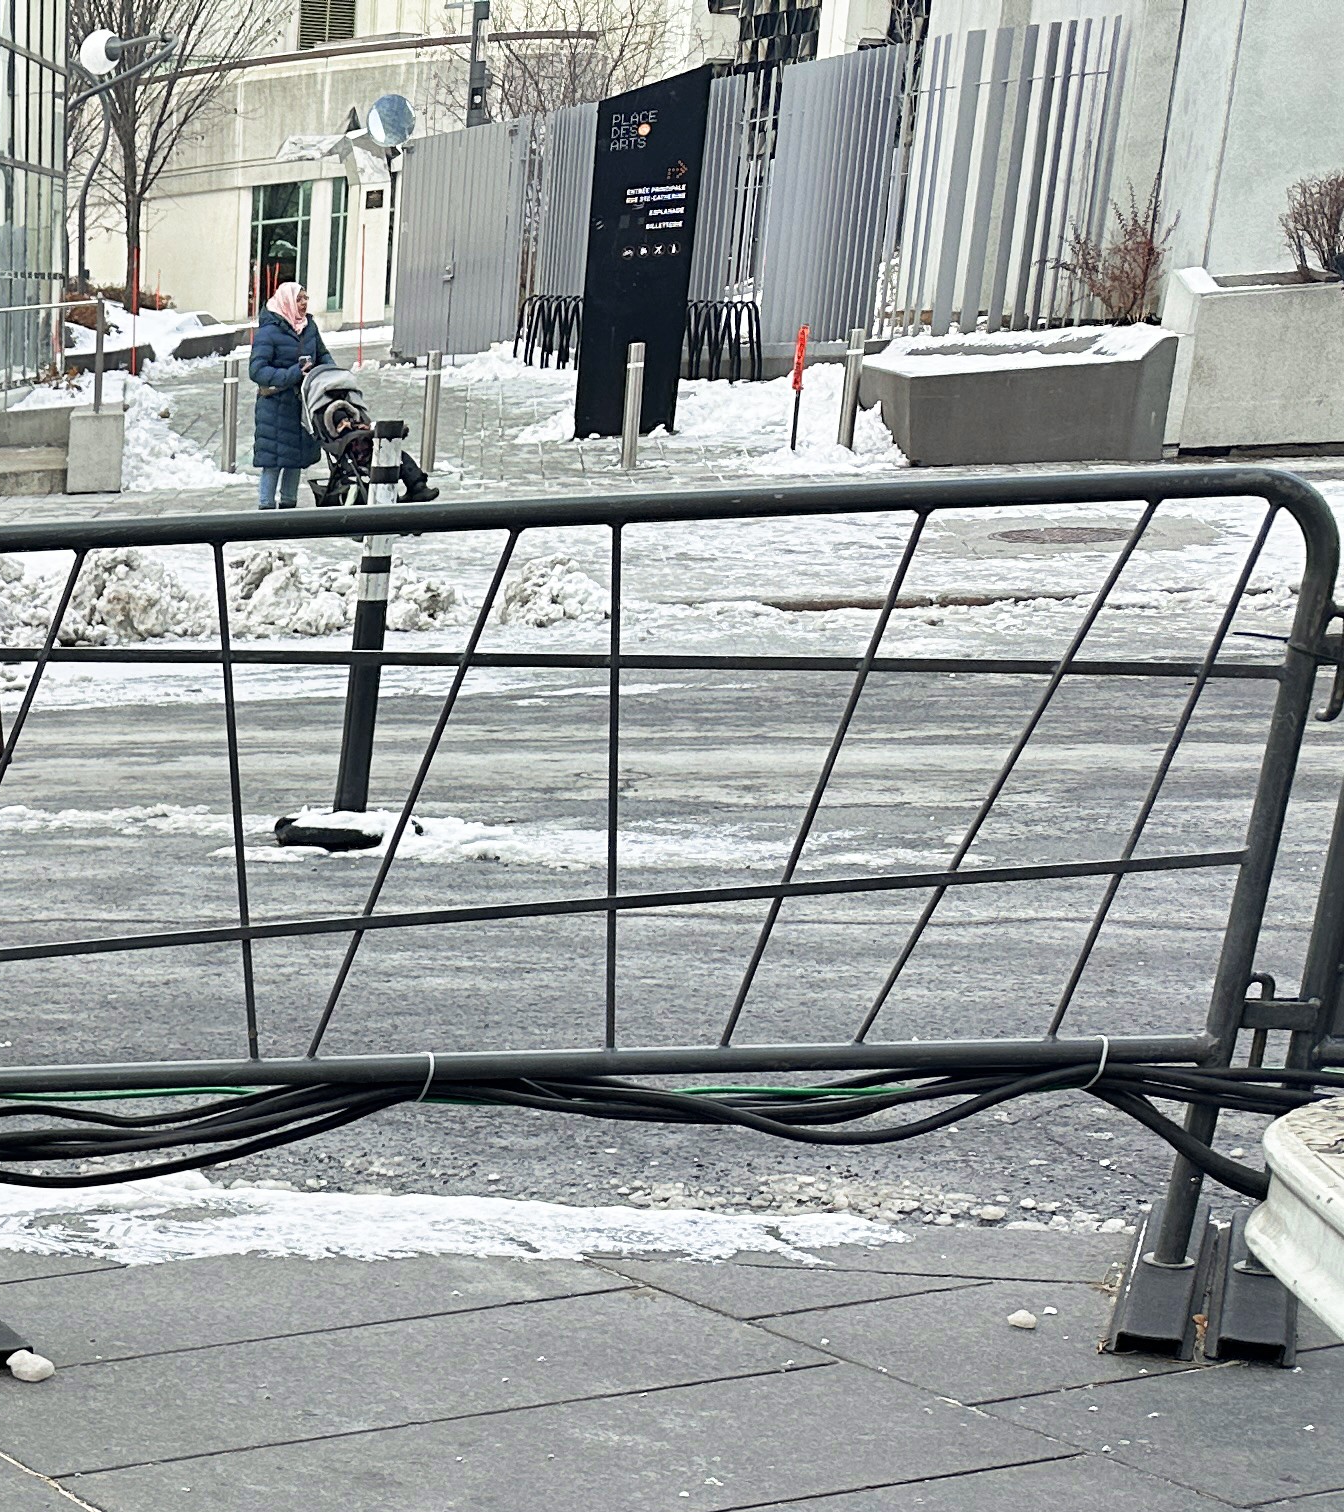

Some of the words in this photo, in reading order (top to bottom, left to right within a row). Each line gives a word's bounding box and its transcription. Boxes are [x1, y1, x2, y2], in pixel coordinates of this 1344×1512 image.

[612, 110, 658, 126] PLACE
[611, 125, 638, 139] DES
[610, 137, 647, 152] ARTS
